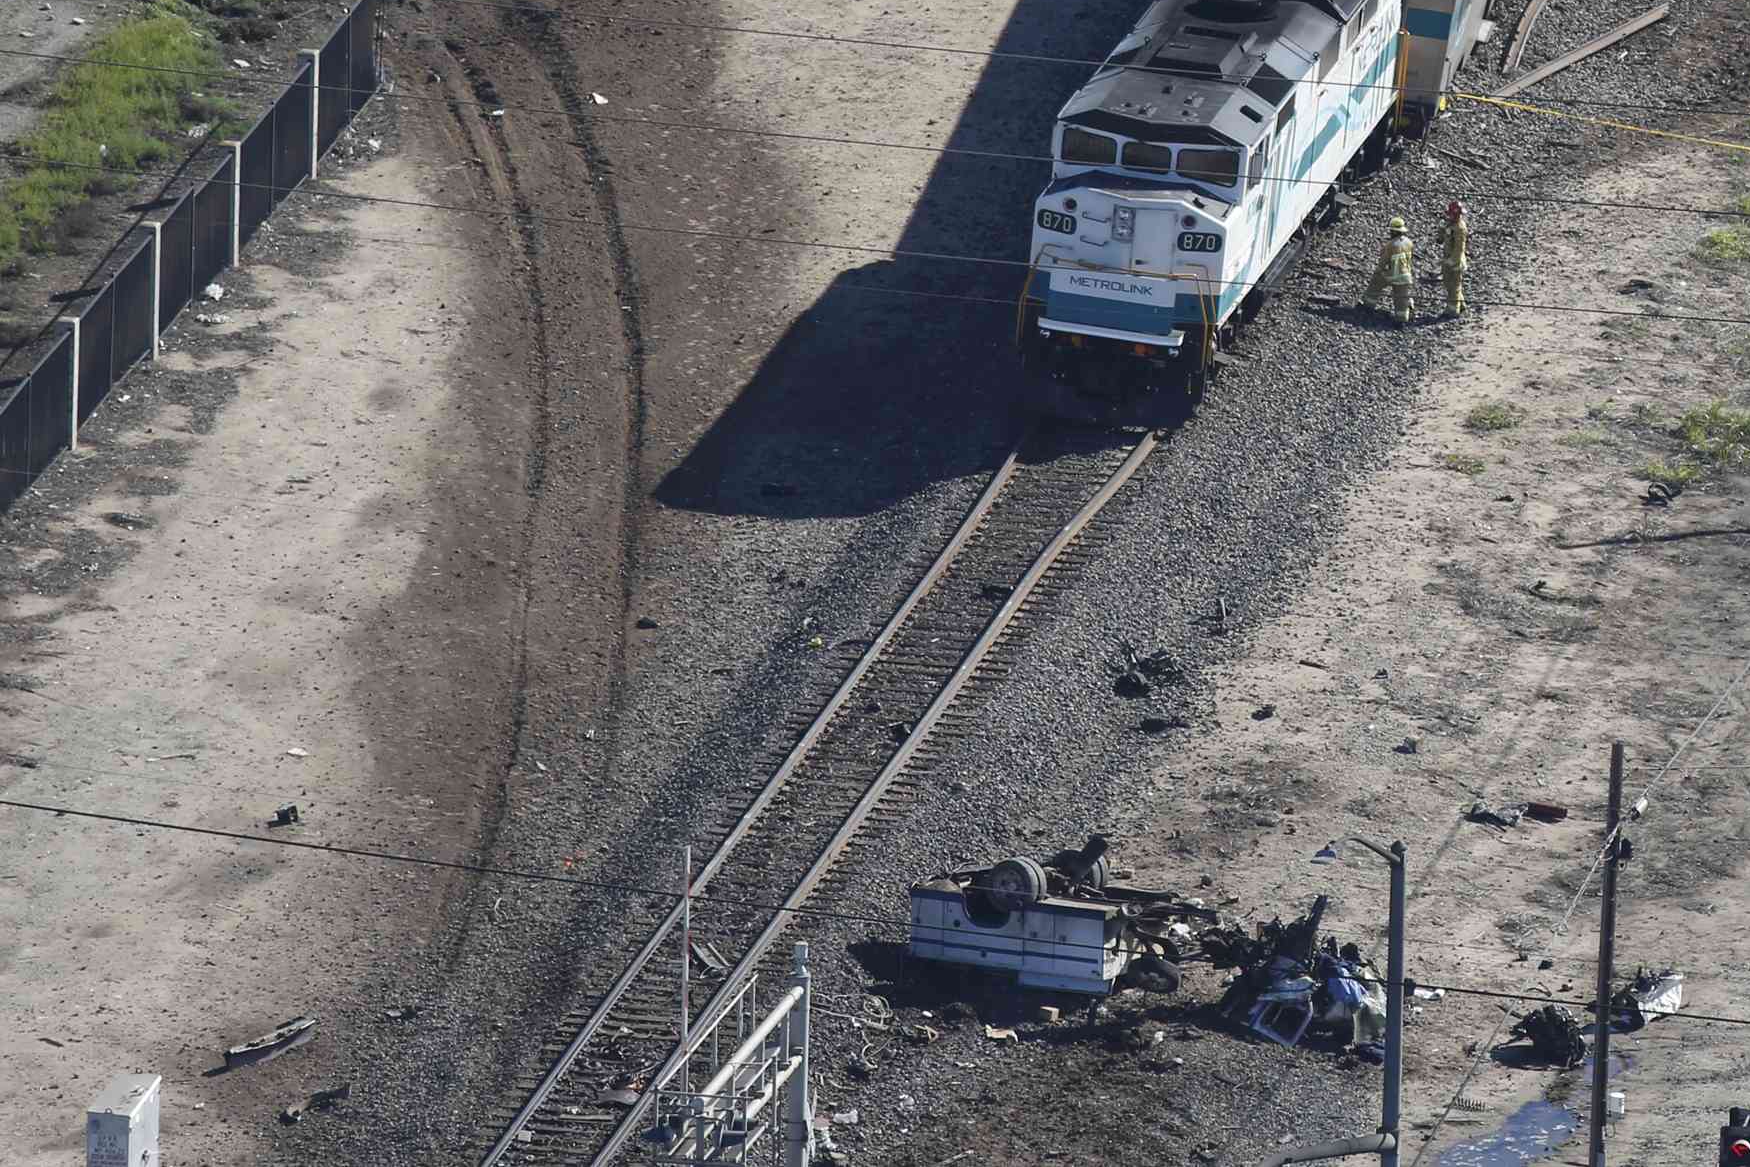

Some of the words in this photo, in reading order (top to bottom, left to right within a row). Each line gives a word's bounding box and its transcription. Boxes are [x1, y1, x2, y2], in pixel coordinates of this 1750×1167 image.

[1042, 211, 1073, 232] 870
[1183, 235, 1216, 251] 870
[1069, 274, 1153, 296] METROLINK
